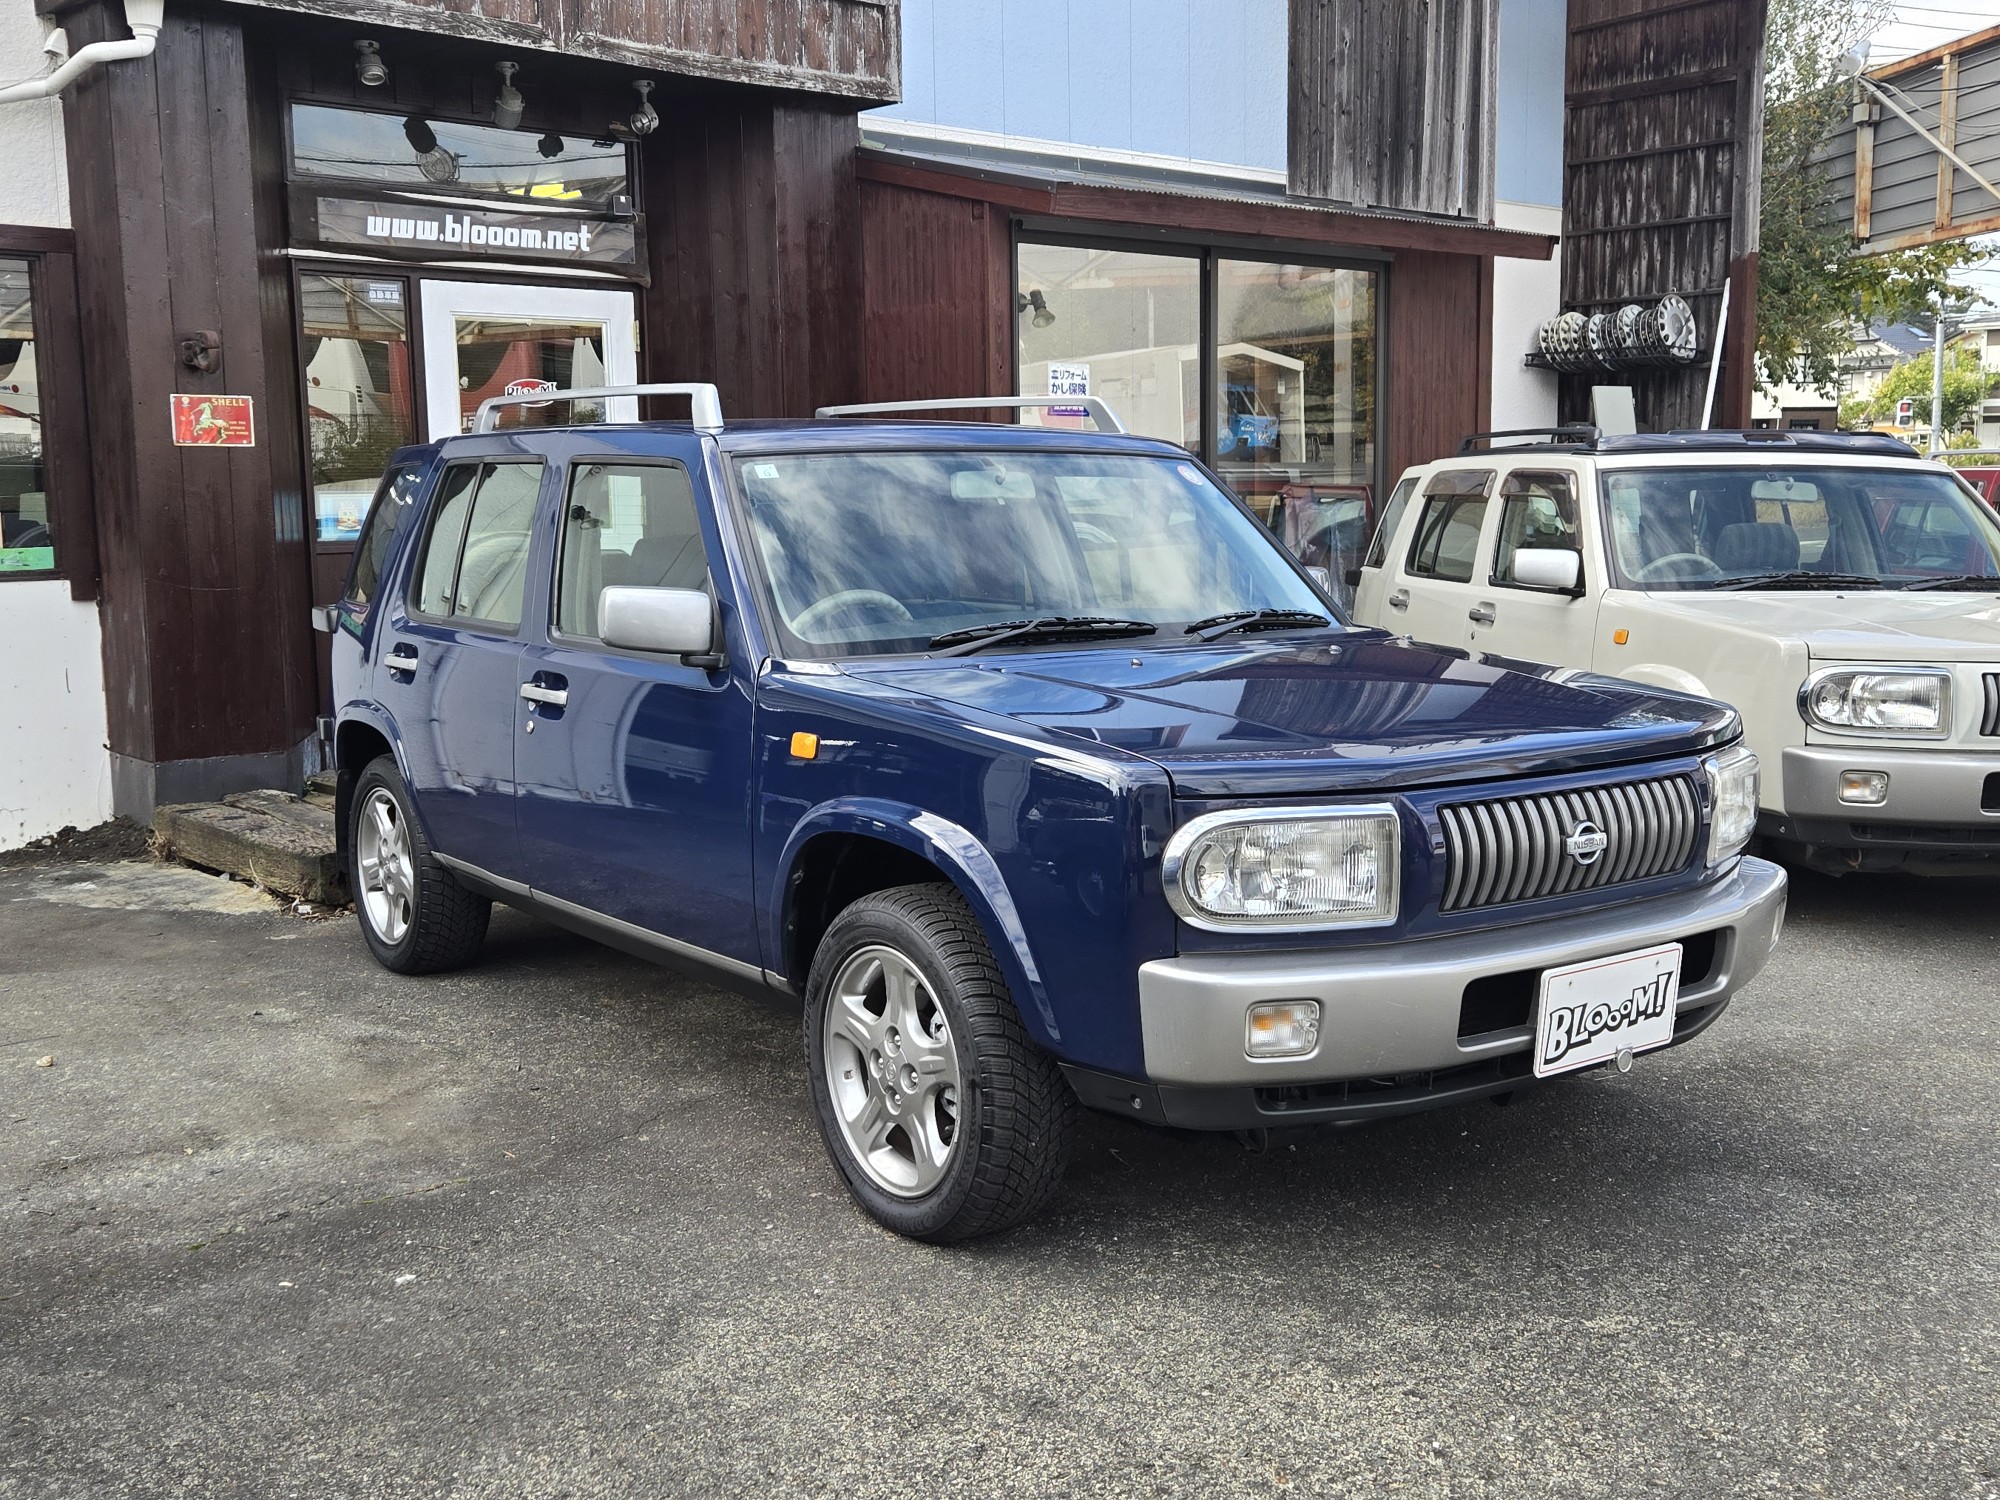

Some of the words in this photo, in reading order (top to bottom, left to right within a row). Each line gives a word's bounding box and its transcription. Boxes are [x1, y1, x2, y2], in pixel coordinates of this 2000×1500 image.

[367, 214, 592, 251] www.blooom.net
[1059, 369, 1087, 381] リフォーム
[1051, 382, 1087, 396] かし保険
[211, 398, 245, 407] SHELL
[1573, 837, 1604, 851] NISSAN
